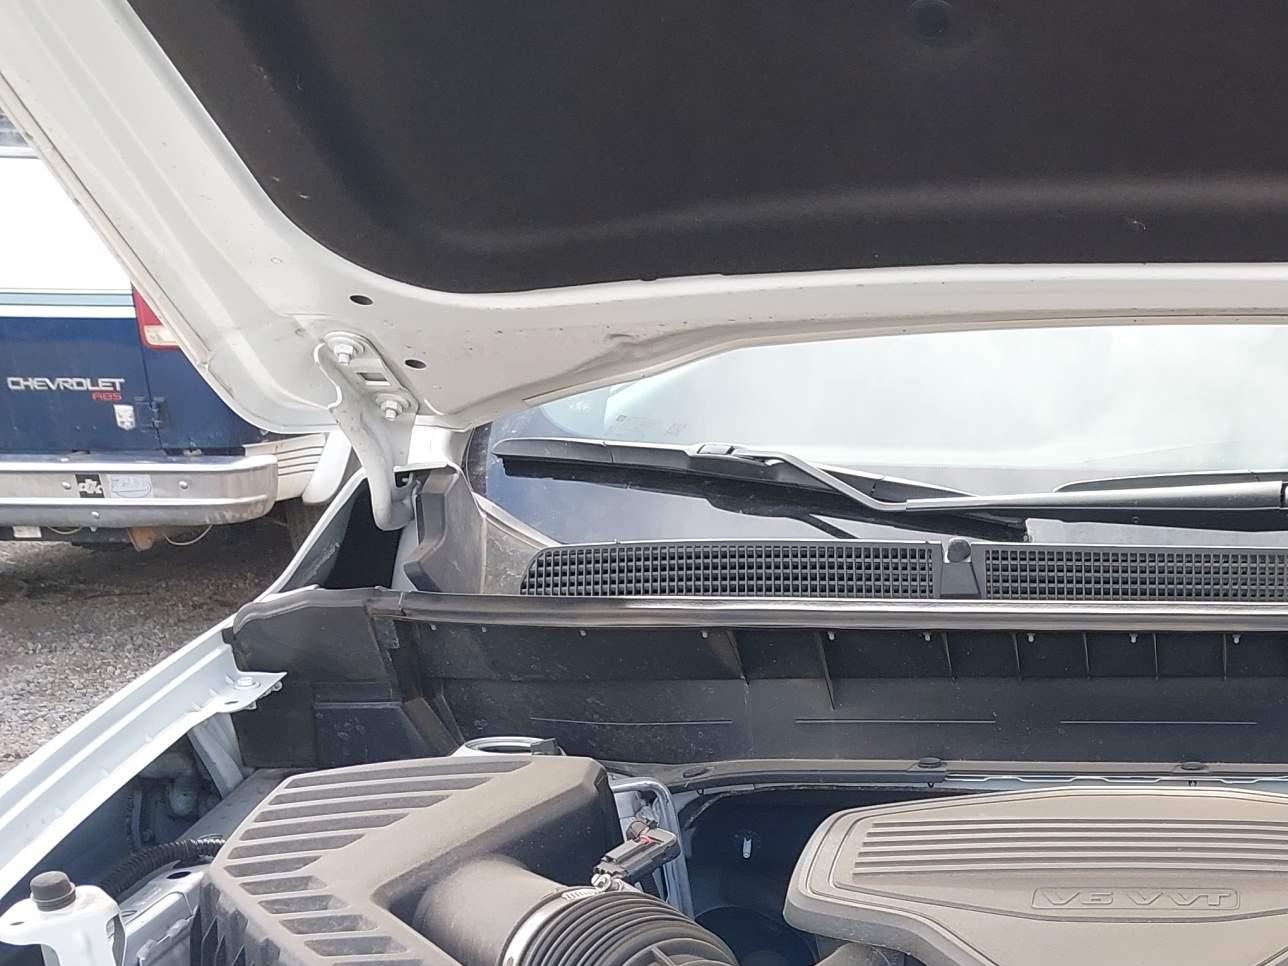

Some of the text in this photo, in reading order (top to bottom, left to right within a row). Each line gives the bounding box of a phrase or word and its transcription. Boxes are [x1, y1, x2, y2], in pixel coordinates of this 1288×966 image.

[7, 377, 125, 391] CHEVROLET
[1040, 891, 1232, 906] V6 VVT
